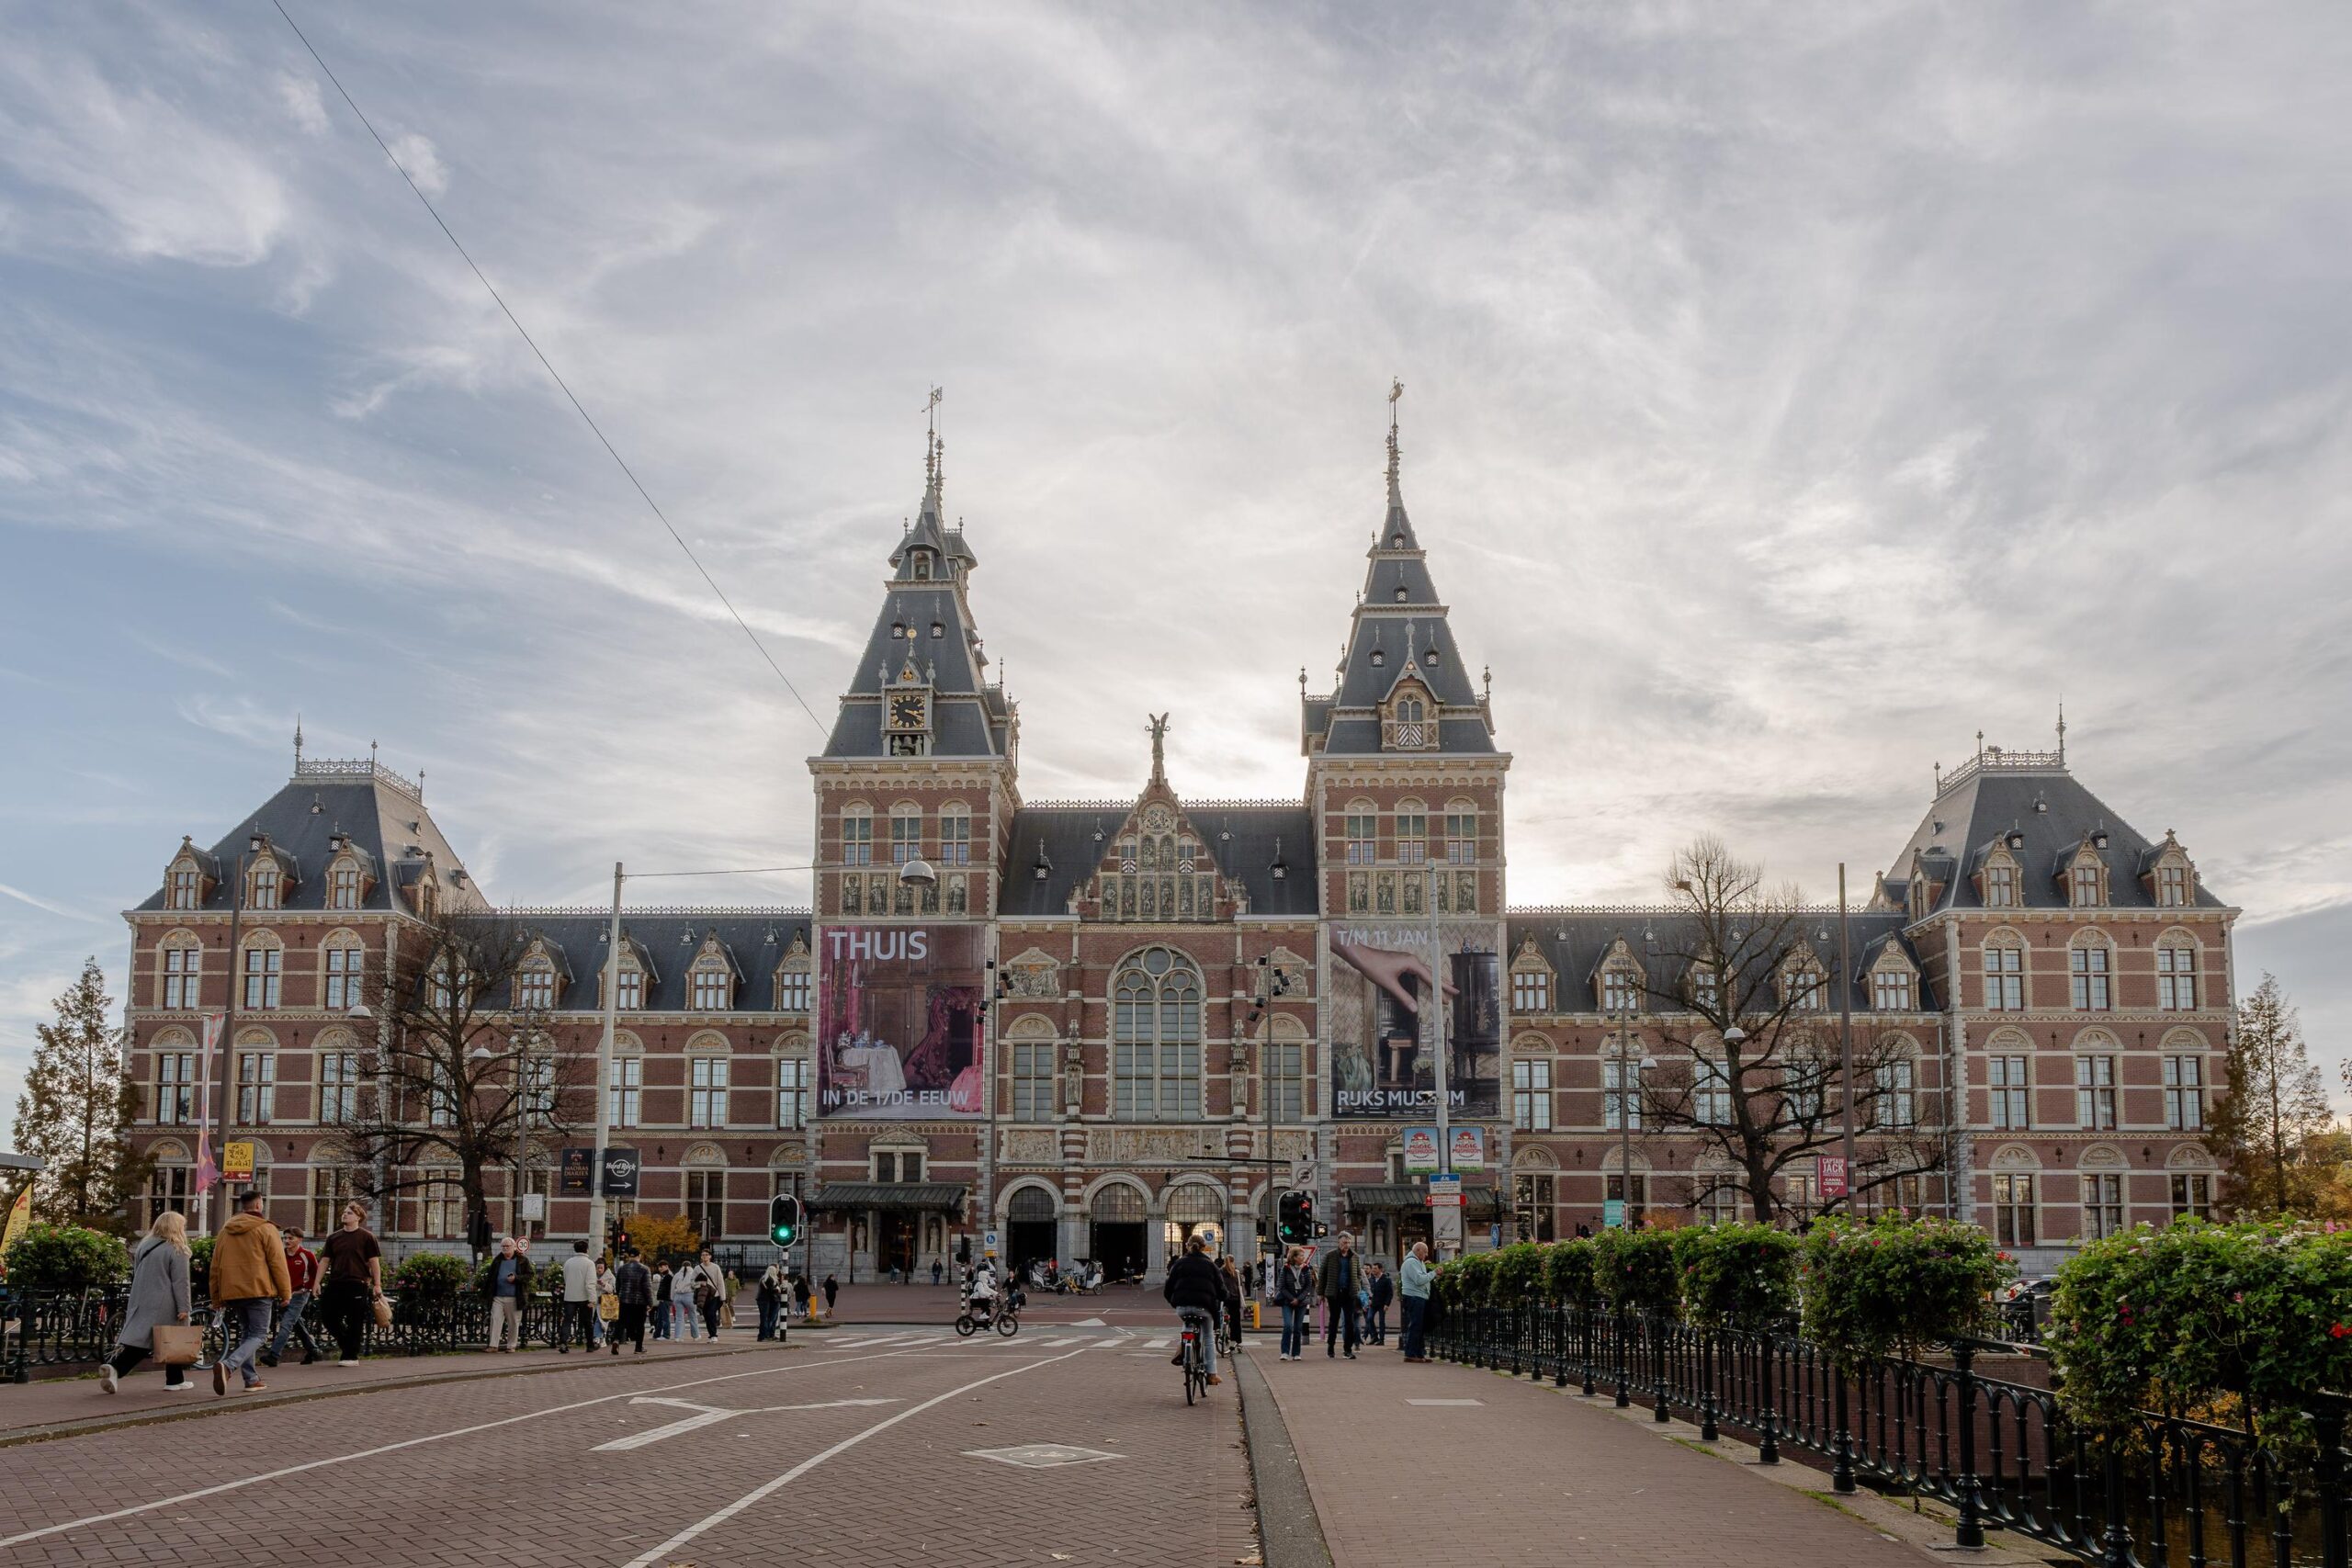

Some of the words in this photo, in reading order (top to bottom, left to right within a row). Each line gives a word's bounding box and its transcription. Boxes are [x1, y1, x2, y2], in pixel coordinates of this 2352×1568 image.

[828, 931, 927, 960] THUIS
[1337, 929, 1368, 947] T/M
[1374, 931, 1387, 945] 11
[1394, 931, 1428, 945] JAN
[823, 1090, 841, 1105] IN
[846, 1090, 868, 1105] DE
[920, 1090, 969, 1105] EEUW
[1338, 1090, 1385, 1106] RIJKS
[1388, 1090, 1464, 1106] MUSM
[621, 1162, 637, 1171] Rock
[1822, 1164, 1844, 1173] JACK
